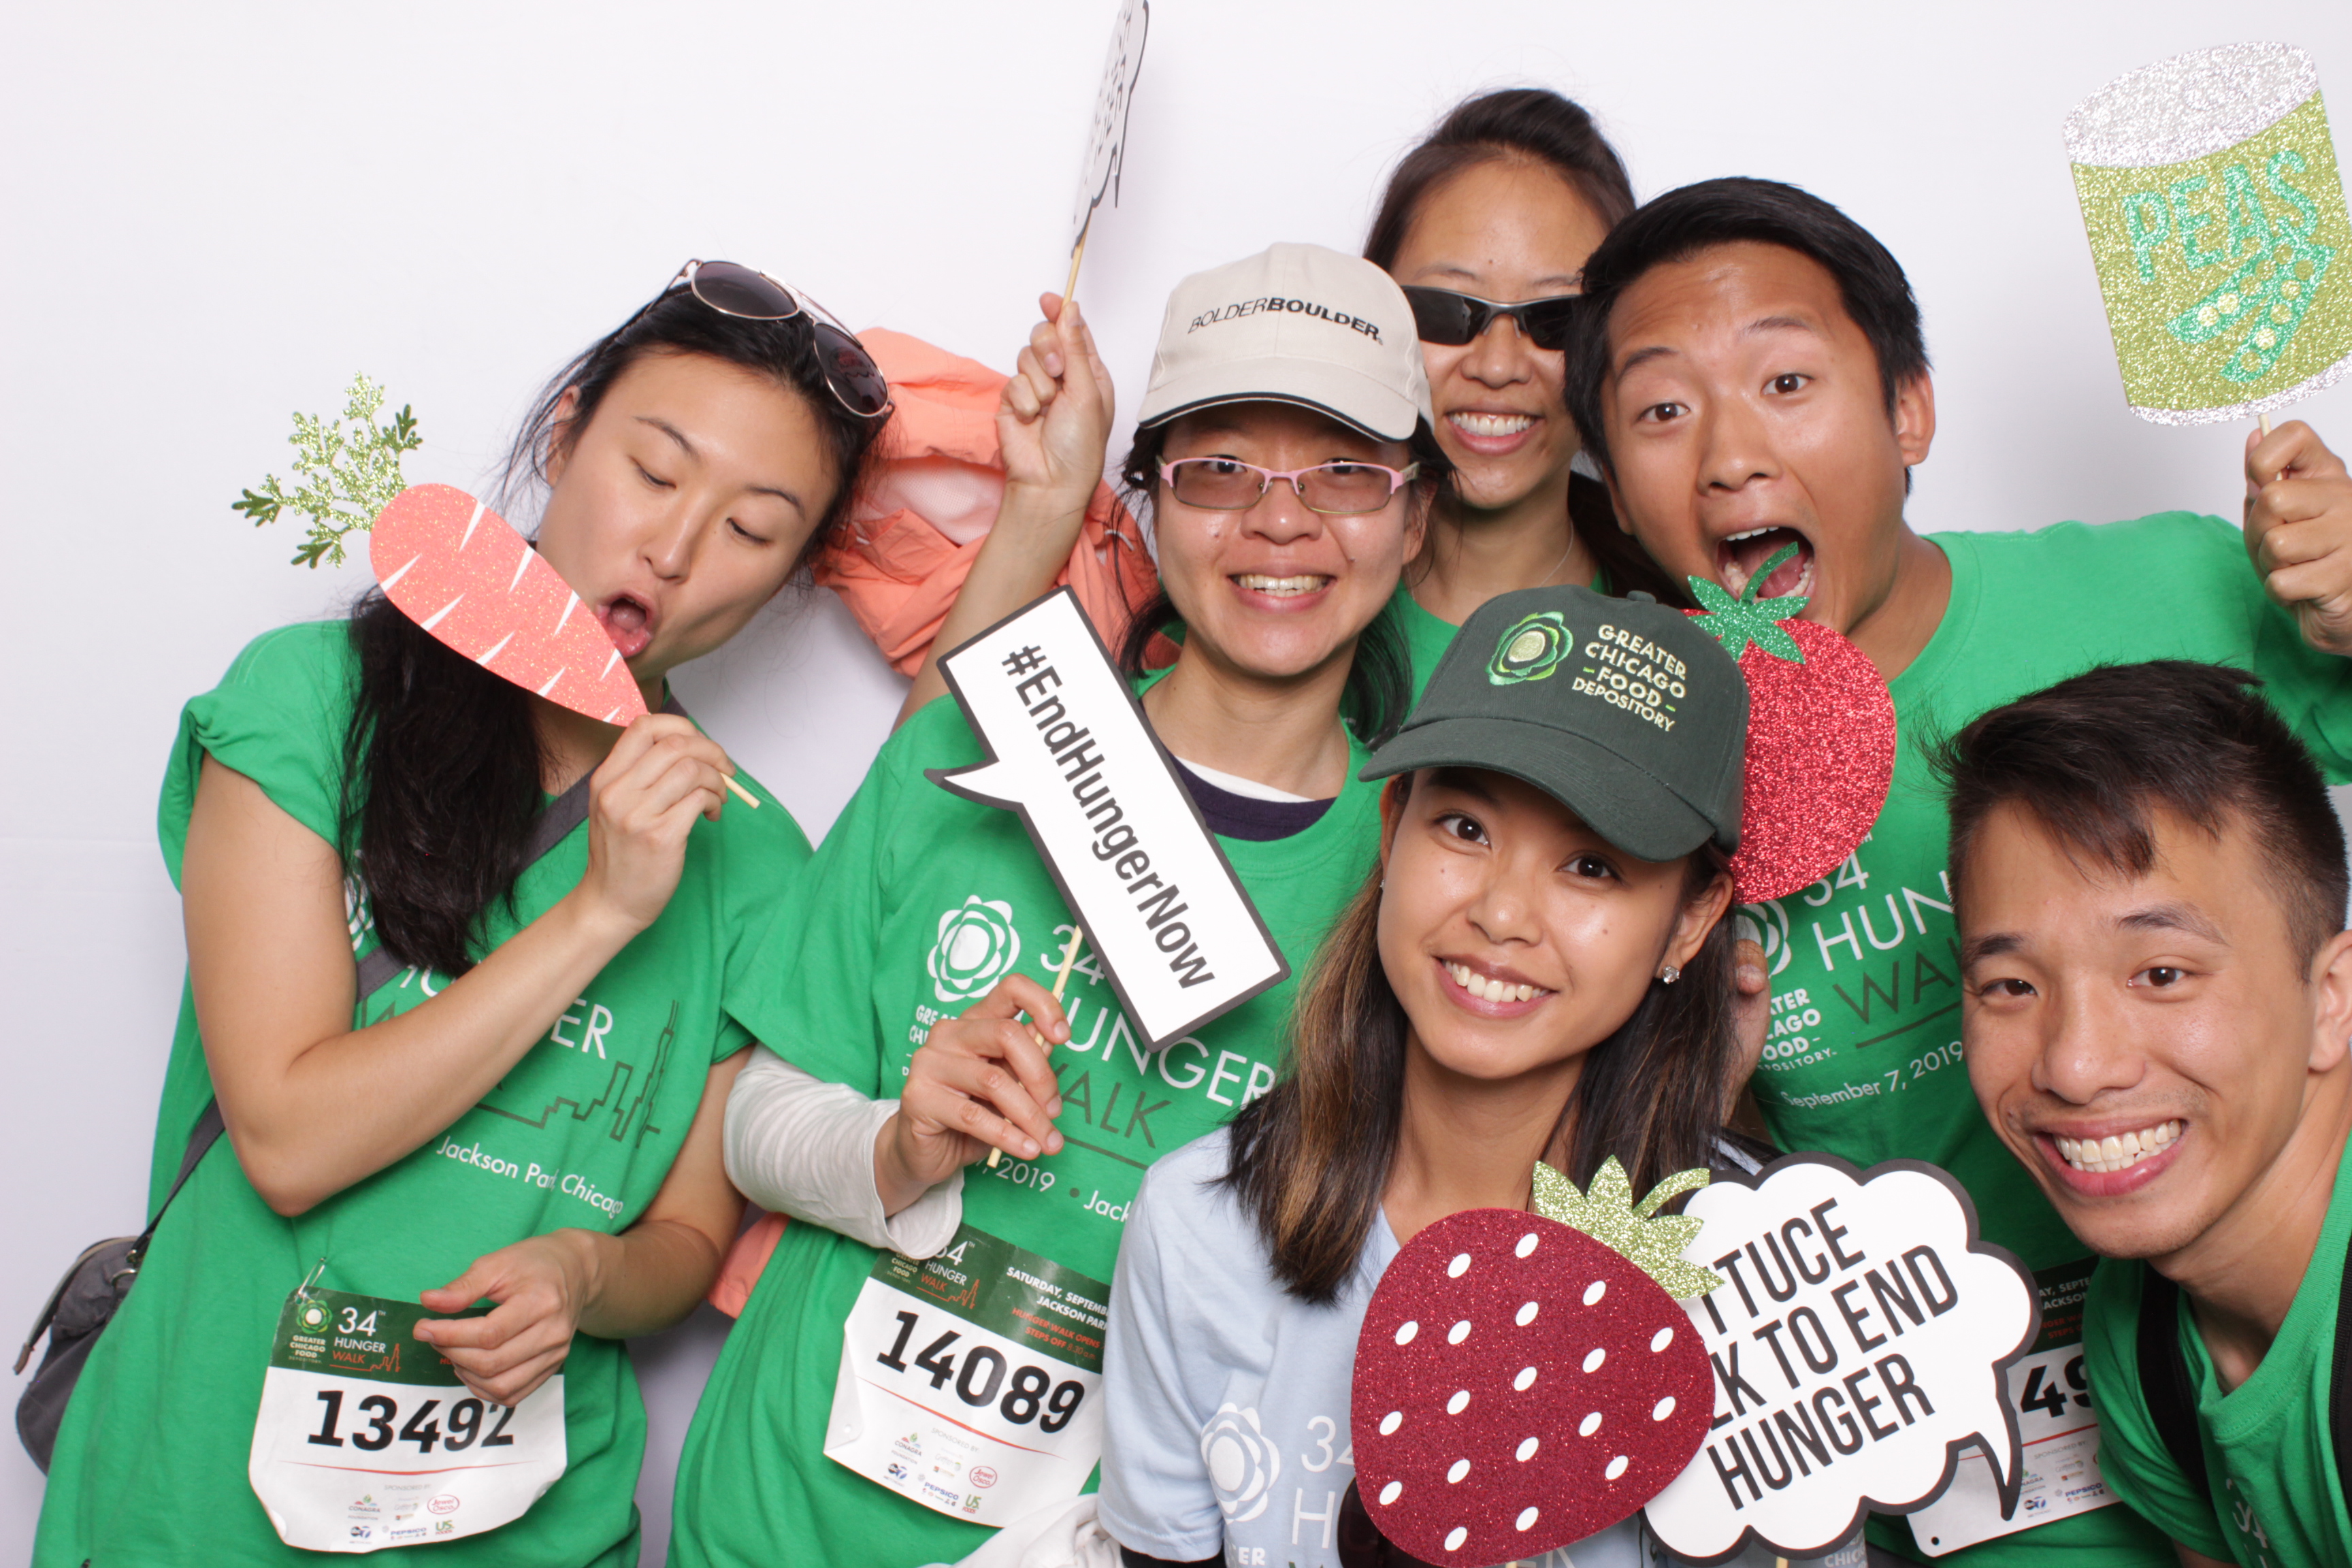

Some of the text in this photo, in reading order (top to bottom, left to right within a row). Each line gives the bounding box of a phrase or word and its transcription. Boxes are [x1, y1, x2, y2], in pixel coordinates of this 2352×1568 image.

[2122, 150, 2318, 285] PEAS
[1598, 624, 1686, 680] GREATER
[1585, 642, 1686, 698] CHICAGO
[1596, 666, 1663, 707] FOOD
[1572, 677, 1675, 732] DEPOSITORY
[1002, 645, 1215, 990] #EndHungerNow
[1054, 1063, 1172, 1149] ALK
[1780, 1083, 1880, 1109] September
[436, 1136, 519, 1179] Jackson
[996, 1157, 1055, 1192] 2019
[892, 1258, 918, 1273] CHICAGO
[893, 1266, 910, 1277] FOOD
[925, 1260, 967, 1286] HUNGER
[921, 1273, 948, 1292] WALK
[1007, 1267, 1109, 1317] SATURDAY, SEPTEMB
[1036, 1296, 1086, 1322] JACKSON
[1752, 1306, 1839, 1390] TO
[1831, 1245, 1959, 1353] END
[293, 1335, 326, 1346] GREATER
[1011, 1307, 1050, 1328] HUNGER
[1049, 1323, 1075, 1339] WALK
[1075, 1334, 1100, 1348] OPENS
[1025, 1326, 1049, 1342] STEPS
[1050, 1337, 1067, 1348] OFF
[289, 1341, 325, 1353] CHICAGO
[294, 1350, 318, 1358] FOOD
[332, 1350, 366, 1364] WALK
[334, 1337, 386, 1354] HUNGER
[877, 1310, 1085, 1433] 14089
[307, 1390, 514, 1453] 13492
[1706, 1353, 1936, 1511] HUNGER
[894, 1440, 922, 1456] CONAGRA
[924, 1482, 959, 1500] PEPSICO
[2065, 1483, 2102, 1497] PEPSICO
